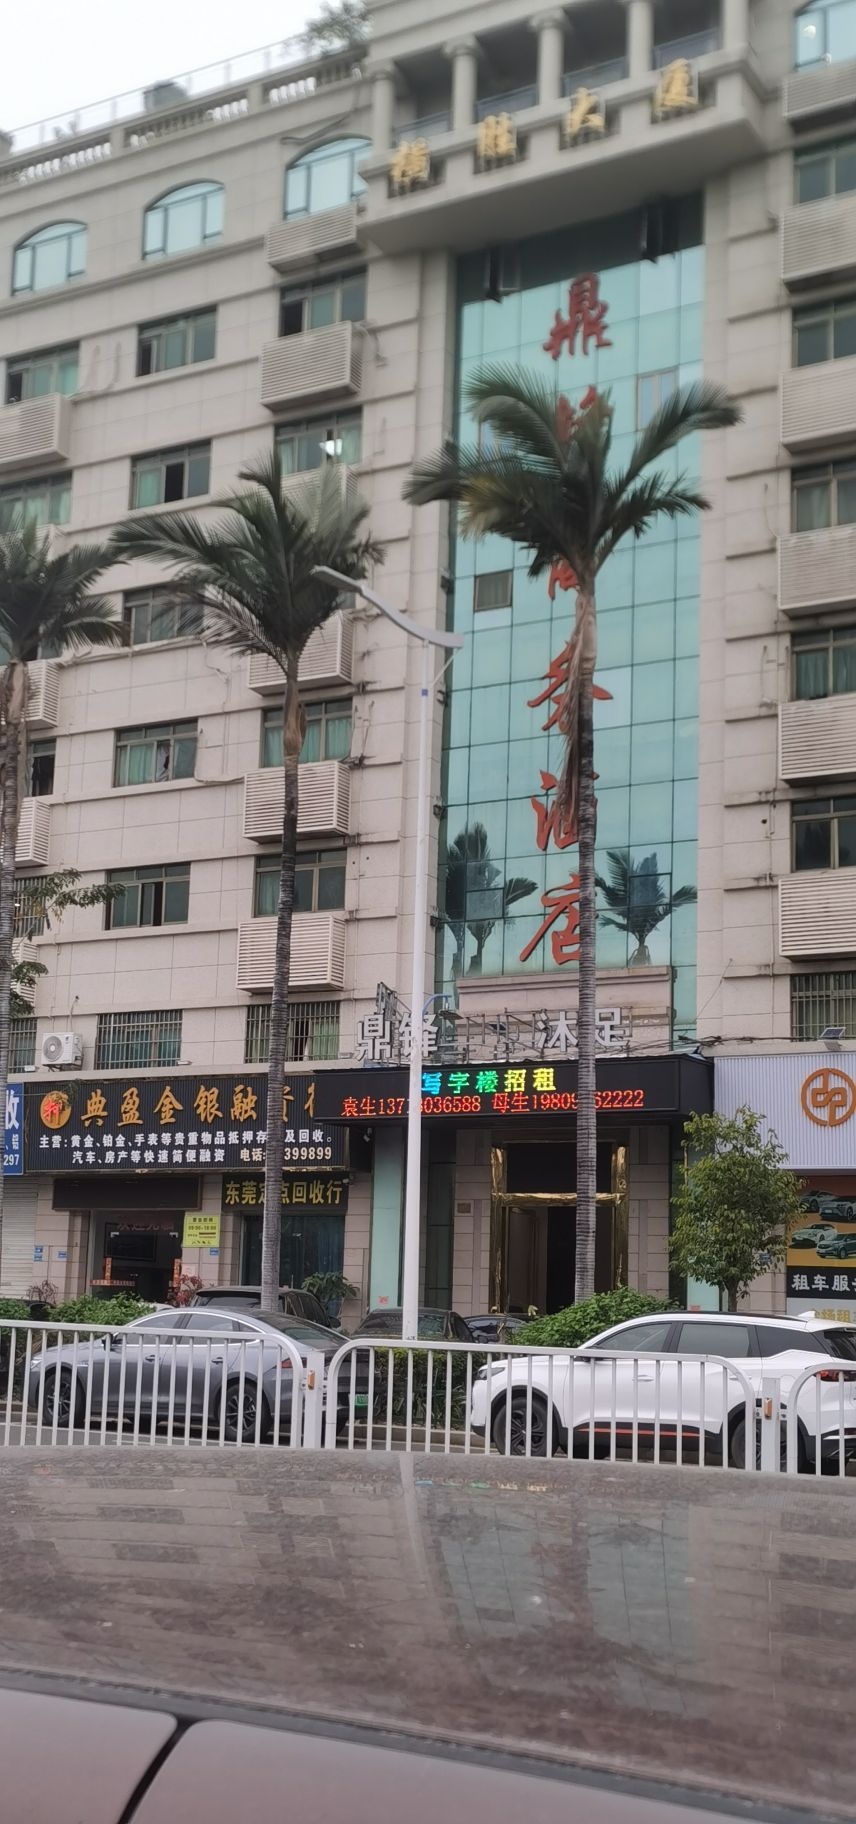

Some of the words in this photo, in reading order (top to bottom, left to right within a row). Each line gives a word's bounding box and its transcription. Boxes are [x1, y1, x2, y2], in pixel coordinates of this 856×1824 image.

[519, 272, 614, 966] 鼎务酒店
[535, 1007, 629, 1052] 沐足
[421, 1068, 557, 1095] 写字楼招租
[341, 1095, 482, 1117] 袁生137036588
[492, 1089, 644, 1114] 母生1980962222
[39, 1129, 332, 1149] 主营：黄金、铂金、手表等贵重物品抵押存及回收。
[72, 1149, 226, 1165] 汽车、房产等快速简便融资
[240, 1147, 332, 1162] 电话:399899
[791, 1273, 856, 1292] 租车服
